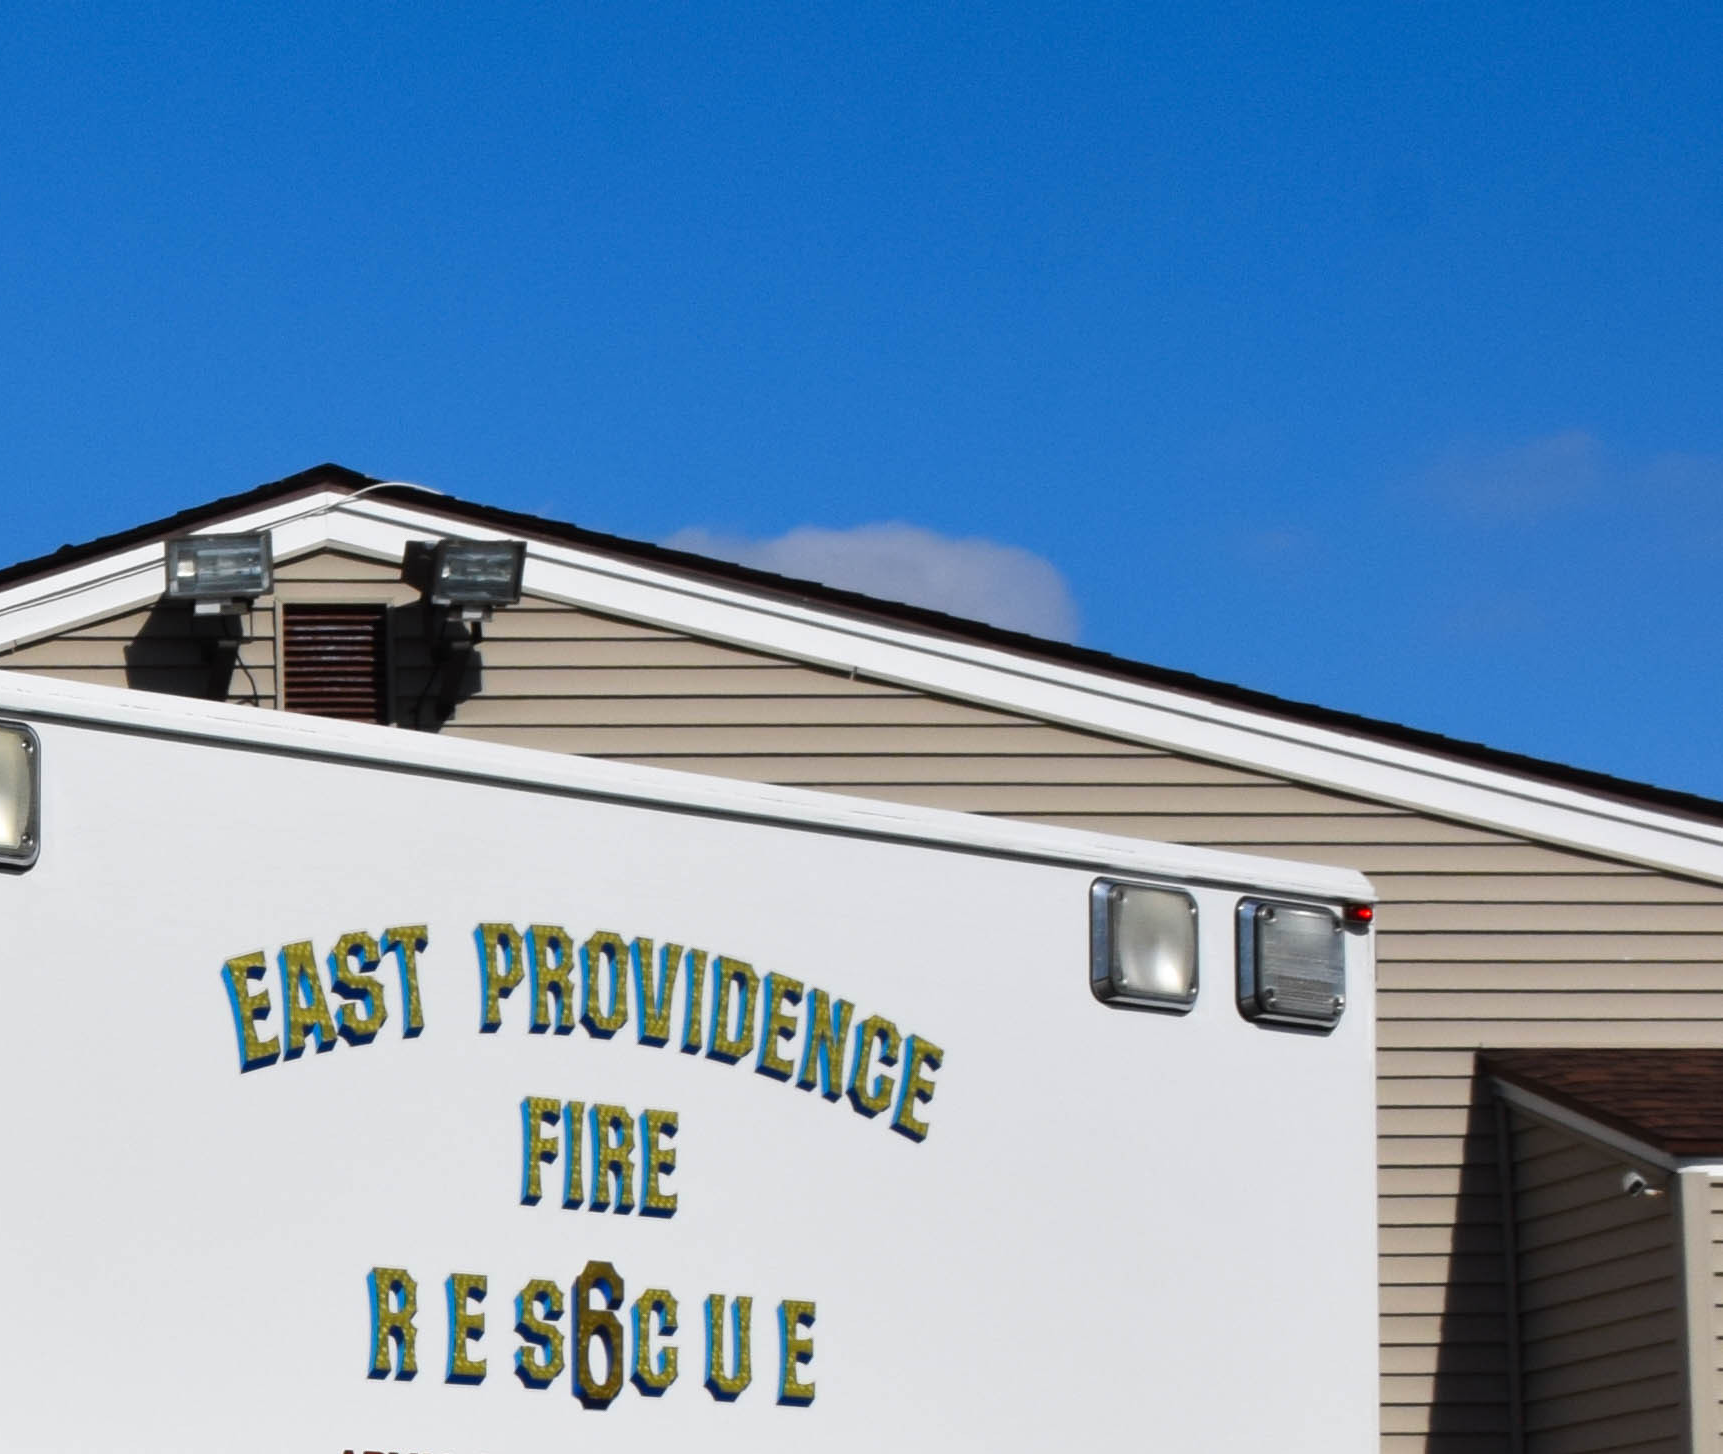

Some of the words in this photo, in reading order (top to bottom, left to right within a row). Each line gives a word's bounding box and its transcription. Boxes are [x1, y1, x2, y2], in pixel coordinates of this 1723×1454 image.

[221, 924, 429, 1074] EAST
[473, 922, 945, 1144] PROVIDENCE
[520, 1095, 679, 1219] FIRE
